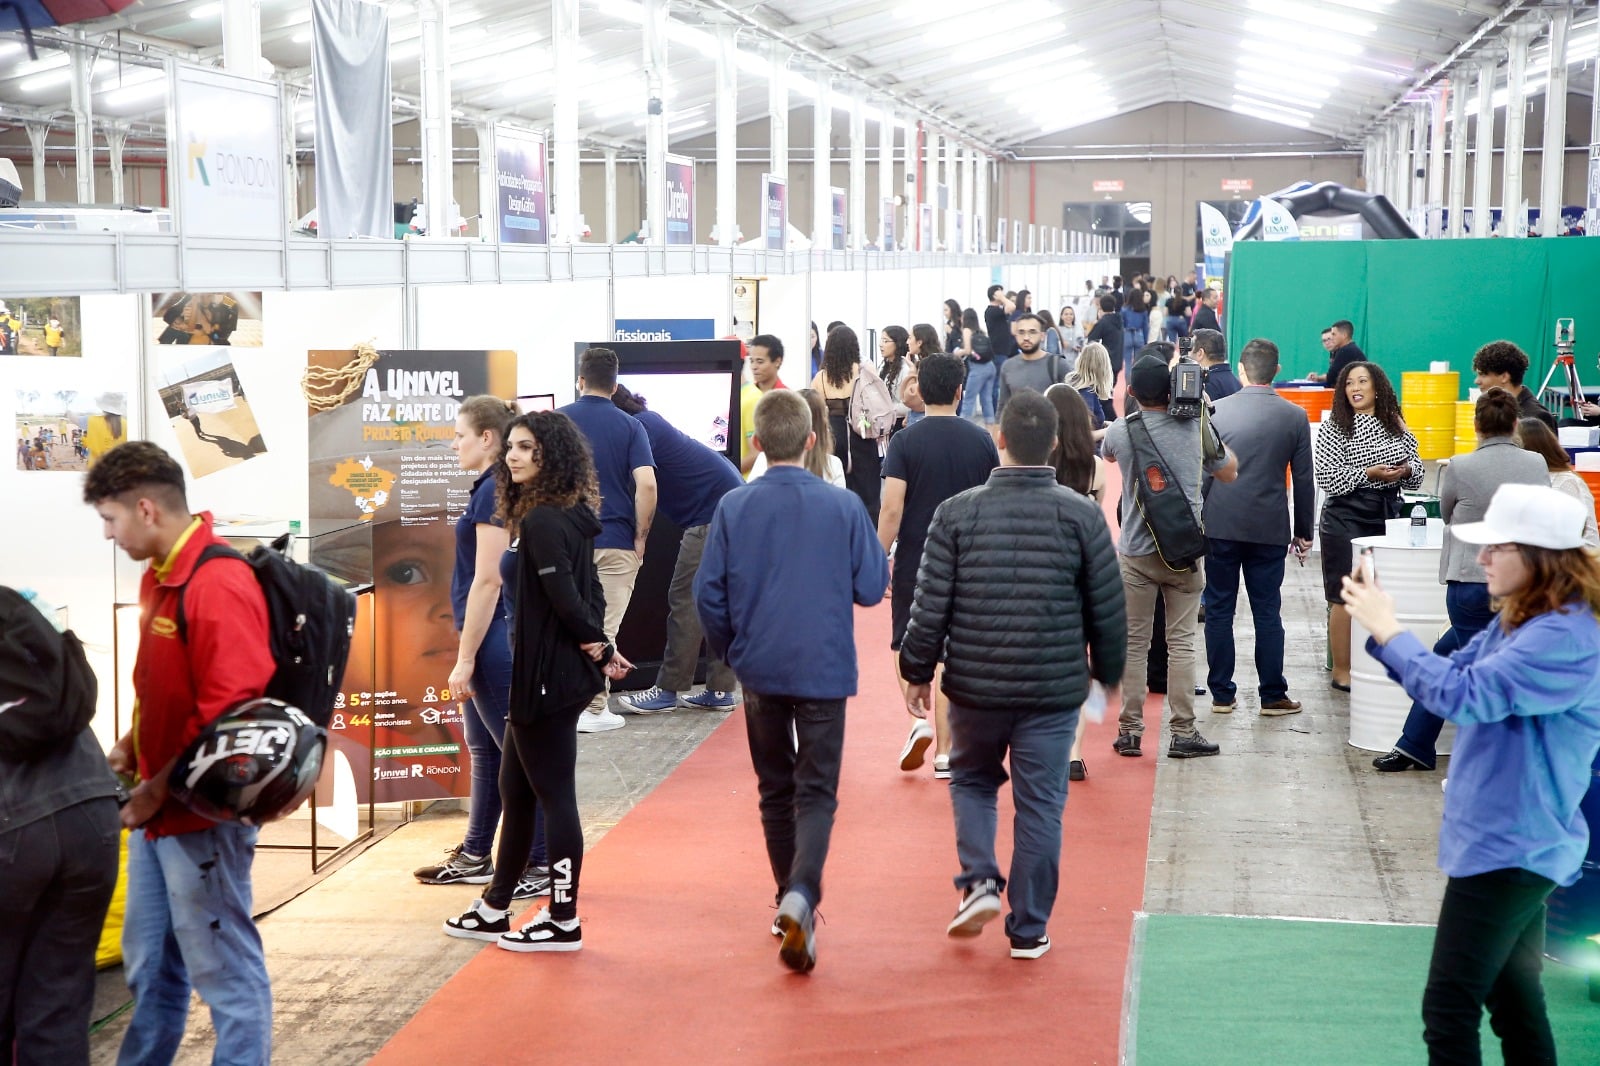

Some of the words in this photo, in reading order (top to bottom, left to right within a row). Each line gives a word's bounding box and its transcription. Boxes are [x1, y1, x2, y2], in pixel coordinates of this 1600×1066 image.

[216, 152, 275, 188] RONDON
[508, 194, 522, 215] Design
[521, 196, 536, 213] Gráfico
[667, 181, 689, 219] Direito
[1205, 237, 1227, 245] CENAP
[615, 329, 672, 341] fissionais
[363, 368, 381, 402] A
[387, 368, 464, 400] UNIVEL
[363, 403, 391, 421] FAZ
[395, 403, 441, 421] PARTE
[363, 425, 412, 441] PROJETO
[414, 422, 456, 442] RONDO
[350, 694, 360, 706] 5
[360, 690, 397, 699] Oprações
[349, 713, 371, 726] 44
[374, 719, 411, 727] ondonistas
[424, 745, 460, 753] CIDADANIA
[381, 768, 408, 777] univel
[426, 766, 461, 774] RONDON
[553, 857, 572, 904] FILA
